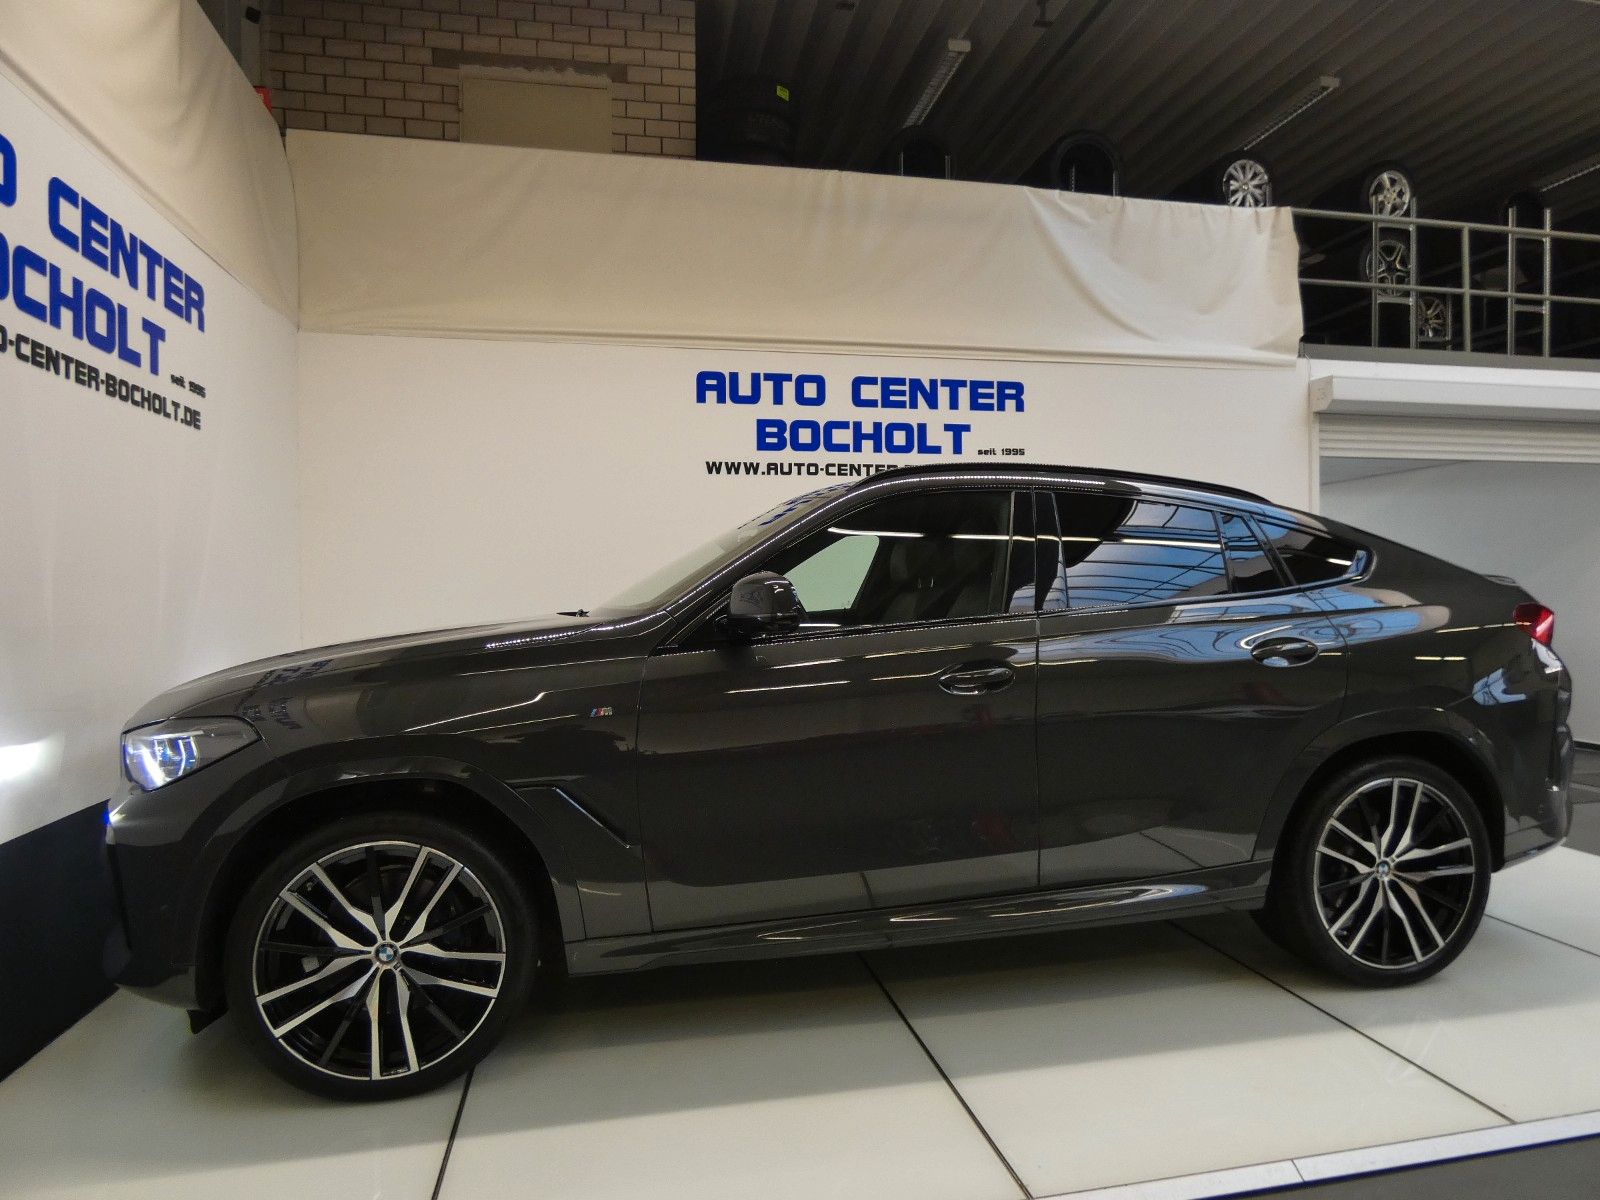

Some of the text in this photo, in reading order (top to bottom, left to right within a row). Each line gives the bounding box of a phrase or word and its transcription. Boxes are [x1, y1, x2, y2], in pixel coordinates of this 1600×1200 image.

[49, 177, 204, 332] CENTER
[0, 233, 165, 376] CHOLT
[696, 371, 1025, 412] AUTO CENTER
[756, 418, 1026, 456] BOCHOLT seit 1995
